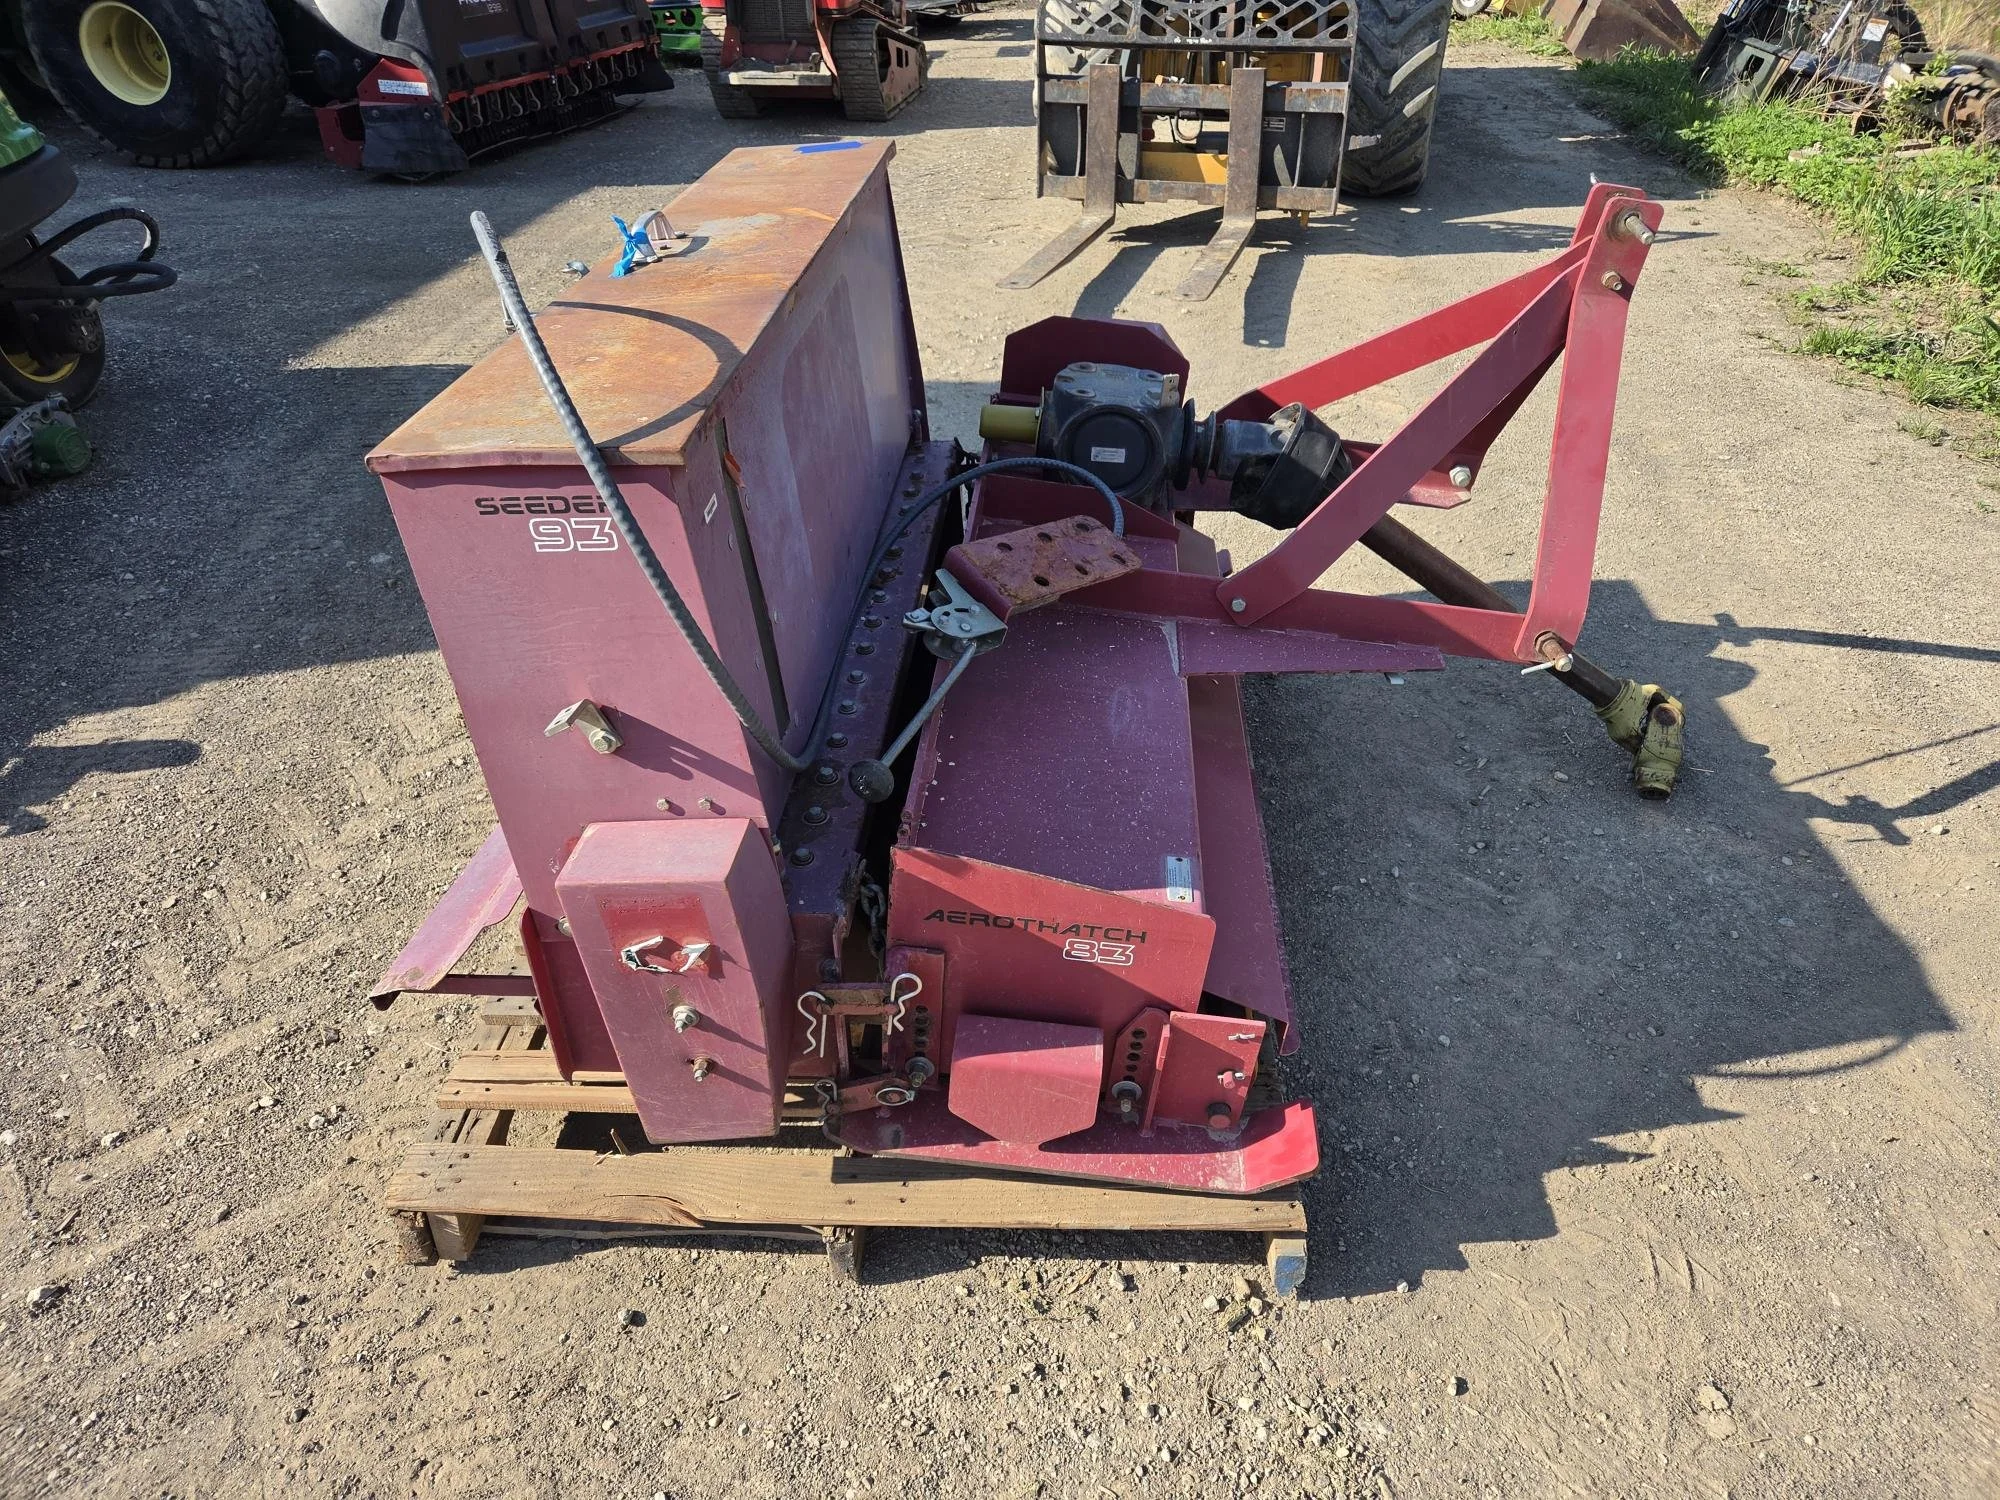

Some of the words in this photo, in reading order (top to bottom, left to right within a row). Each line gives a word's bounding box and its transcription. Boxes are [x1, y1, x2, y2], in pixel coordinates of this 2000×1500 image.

[529, 517, 619, 552] 93
[924, 909, 1147, 943] AEROTHATCH
[1063, 938, 1134, 966] 83
